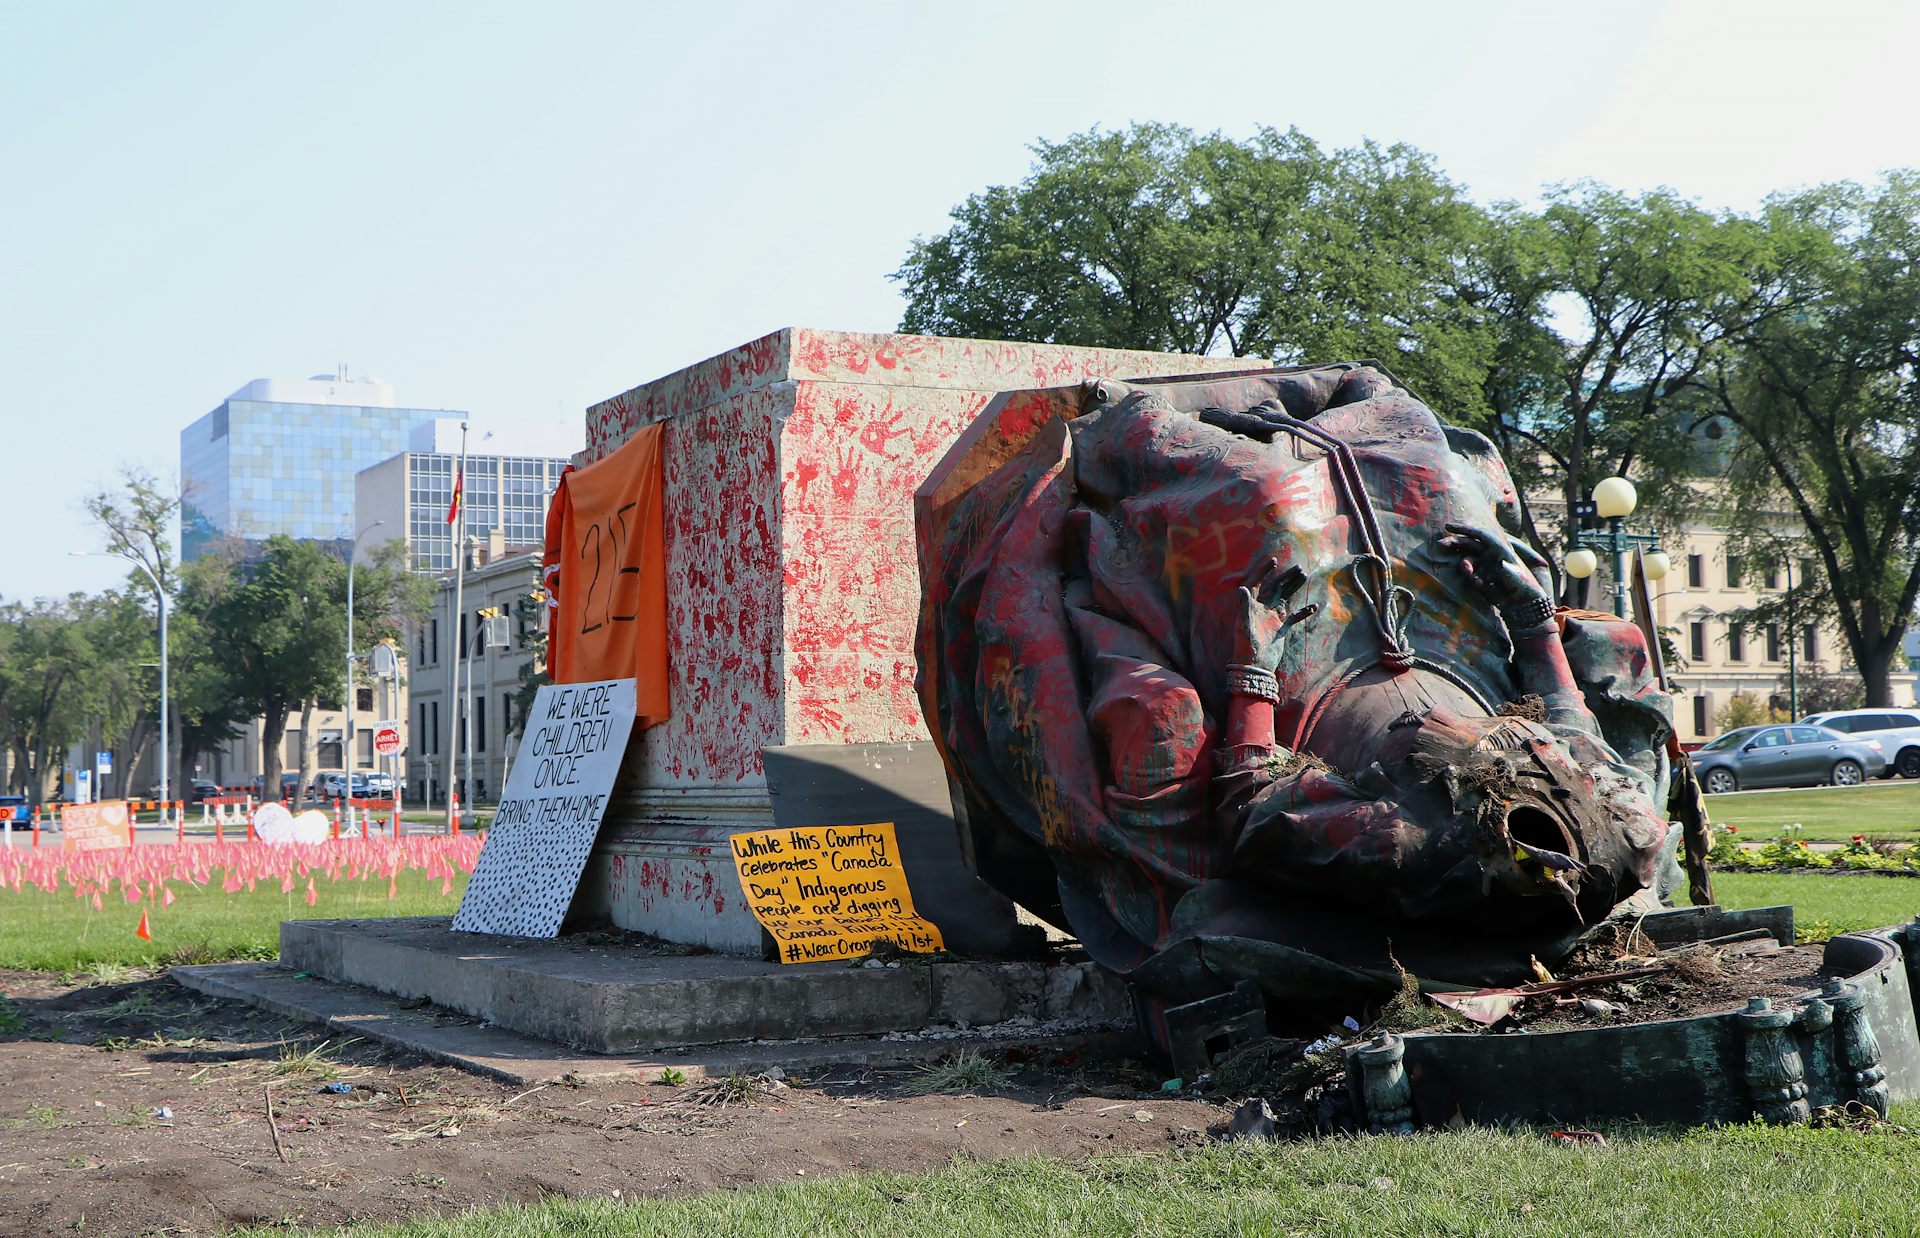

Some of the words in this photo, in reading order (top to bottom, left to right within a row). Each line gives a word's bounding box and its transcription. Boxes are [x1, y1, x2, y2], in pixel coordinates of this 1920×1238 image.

[581, 501, 640, 635] 215
[546, 689, 573, 720] WE
[570, 683, 618, 719] WERE
[379, 742, 397, 752] STOP
[532, 718, 614, 757] CHILDREN
[534, 755, 585, 789] ONCE.
[494, 800, 535, 828] BRING
[536, 796, 573, 823] THEM
[566, 794, 606, 823] HOME
[732, 834, 784, 858] While
[788, 830, 821, 851] this
[825, 828, 885, 857] Country
[821, 850, 893, 872] "Canada
[750, 875, 789, 904] Day"
[795, 875, 887, 906] Indigenous
[812, 904, 843, 916] are
[847, 897, 901, 917] digging
[763, 920, 789, 930] up
[797, 918, 824, 927] our
[775, 928, 843, 941] Canada
[786, 938, 882, 961] #WearOran
[911, 932, 934, 948] 1st
